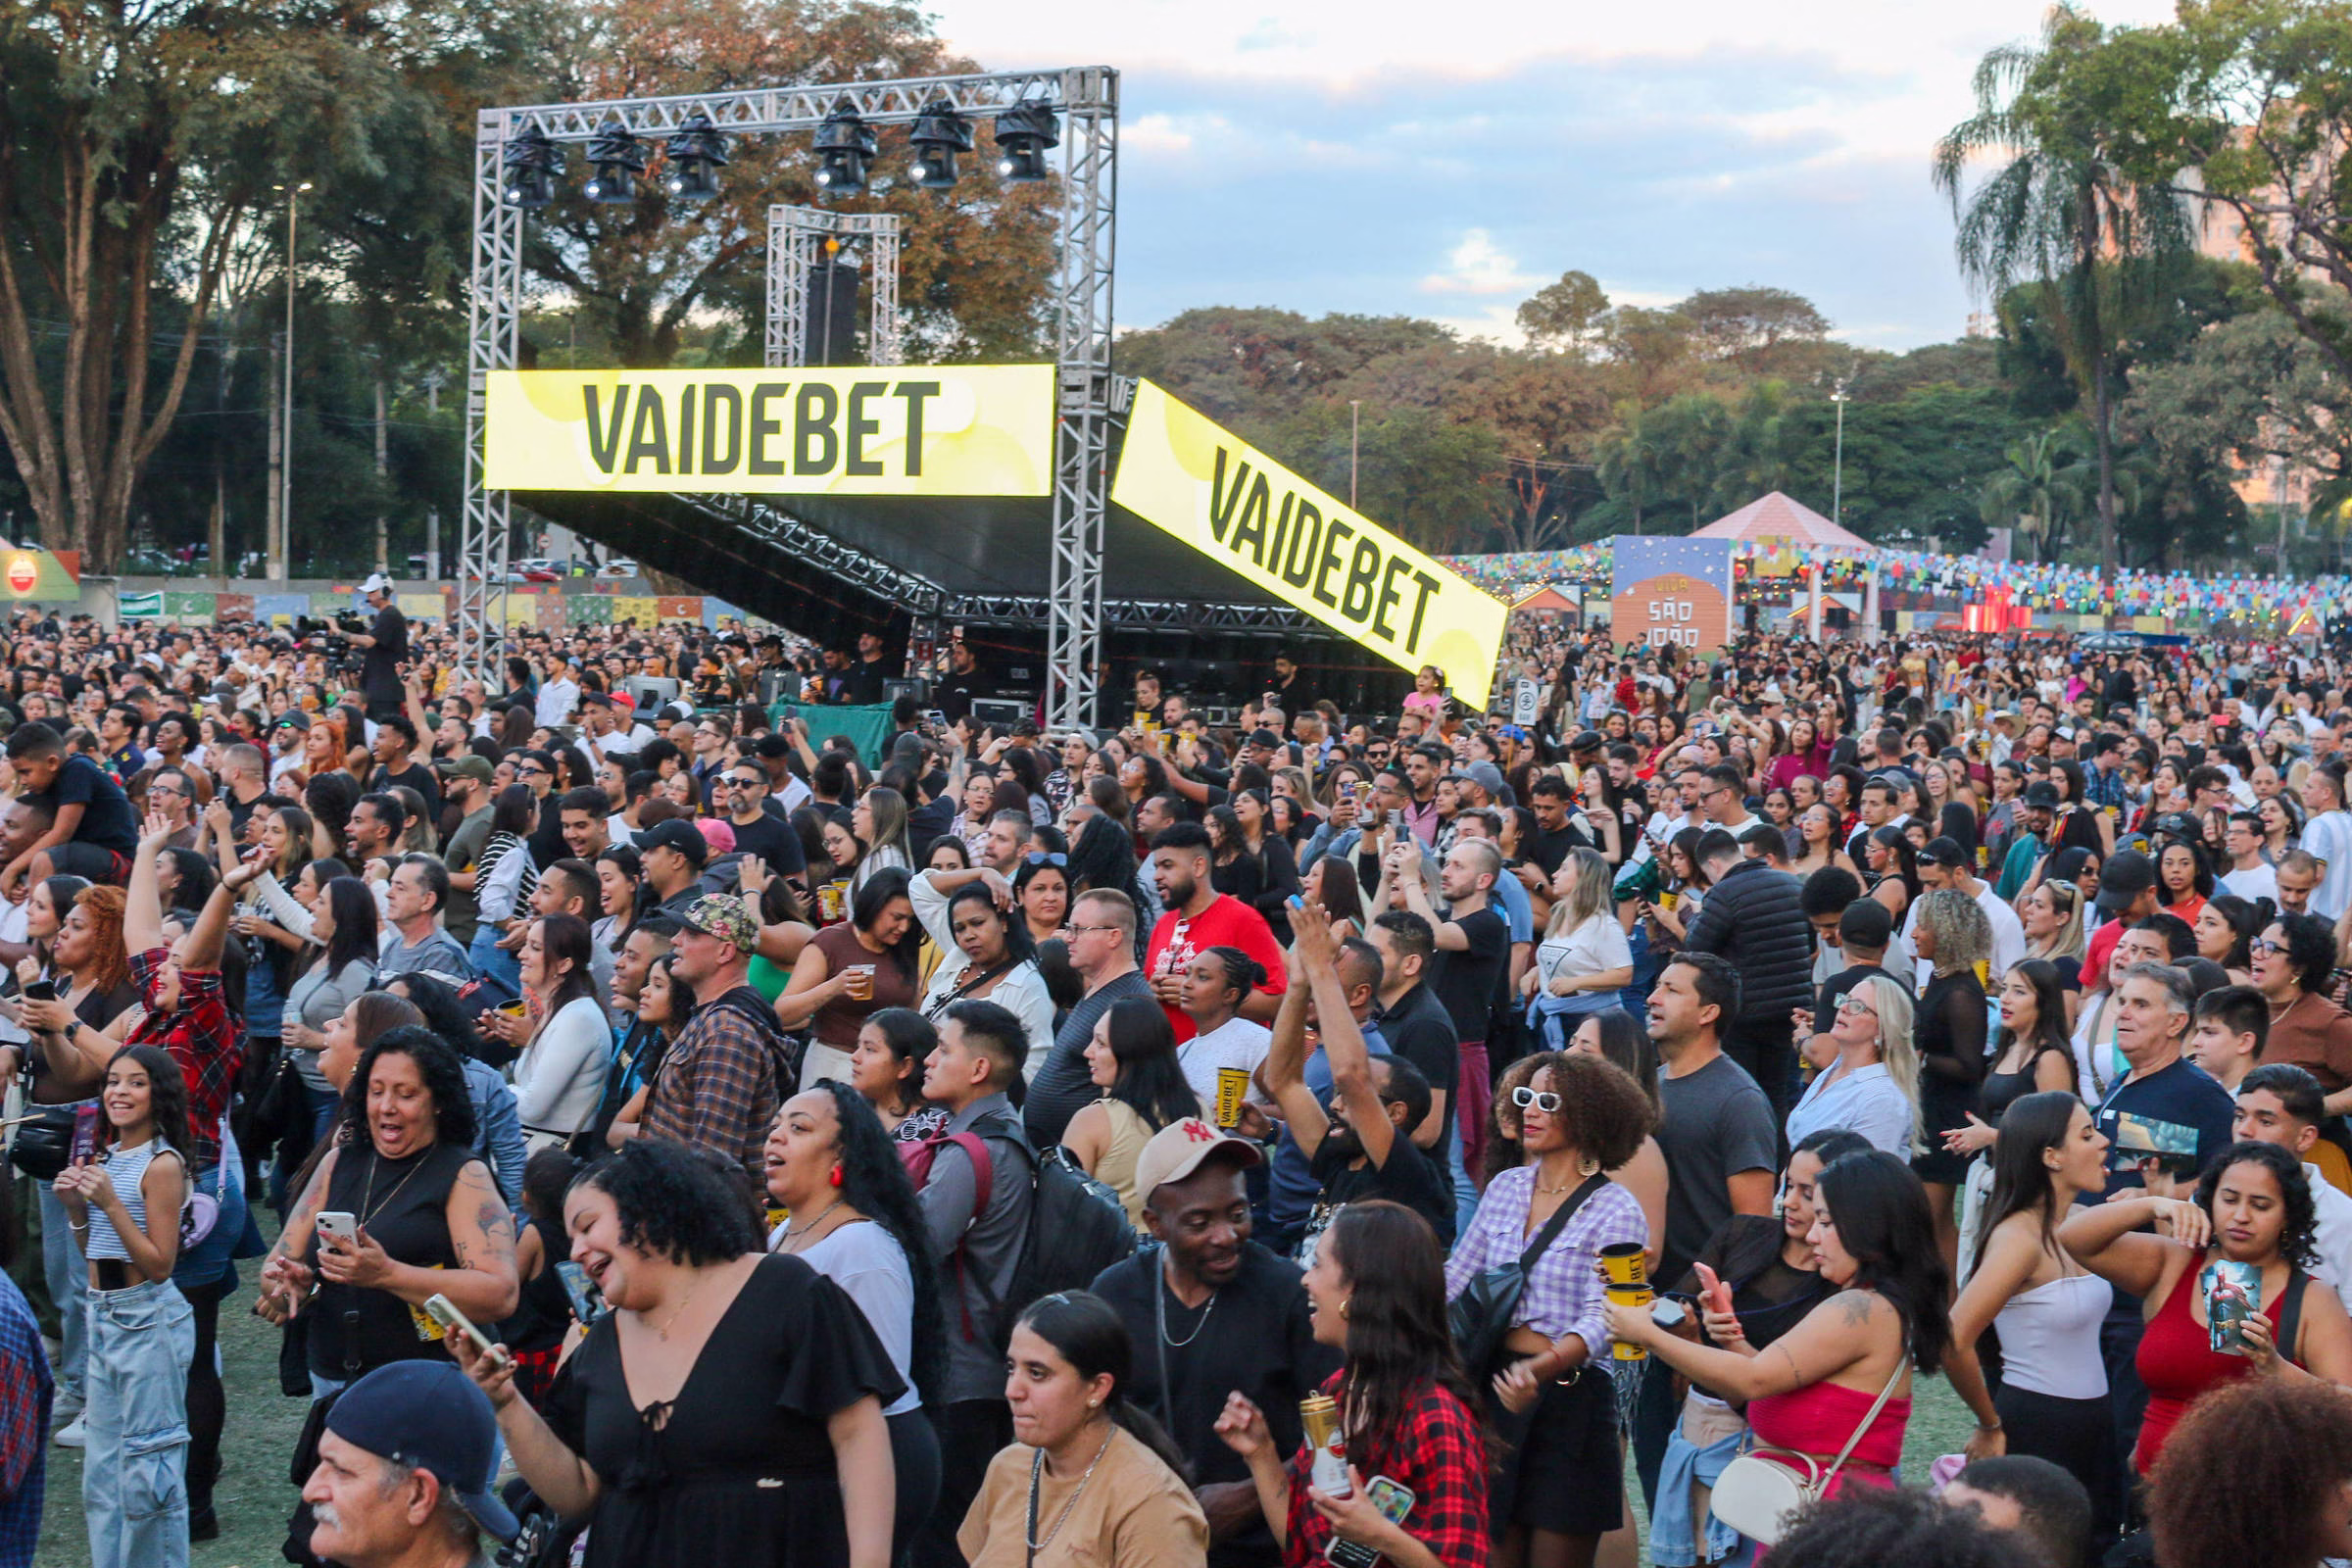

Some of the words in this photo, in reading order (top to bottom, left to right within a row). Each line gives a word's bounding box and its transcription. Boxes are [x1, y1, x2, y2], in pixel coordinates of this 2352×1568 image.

[583, 380, 941, 477] VAIDEBET
[1209, 445, 1442, 656] VAIDEBET
[1648, 597, 1692, 621] SÃO
